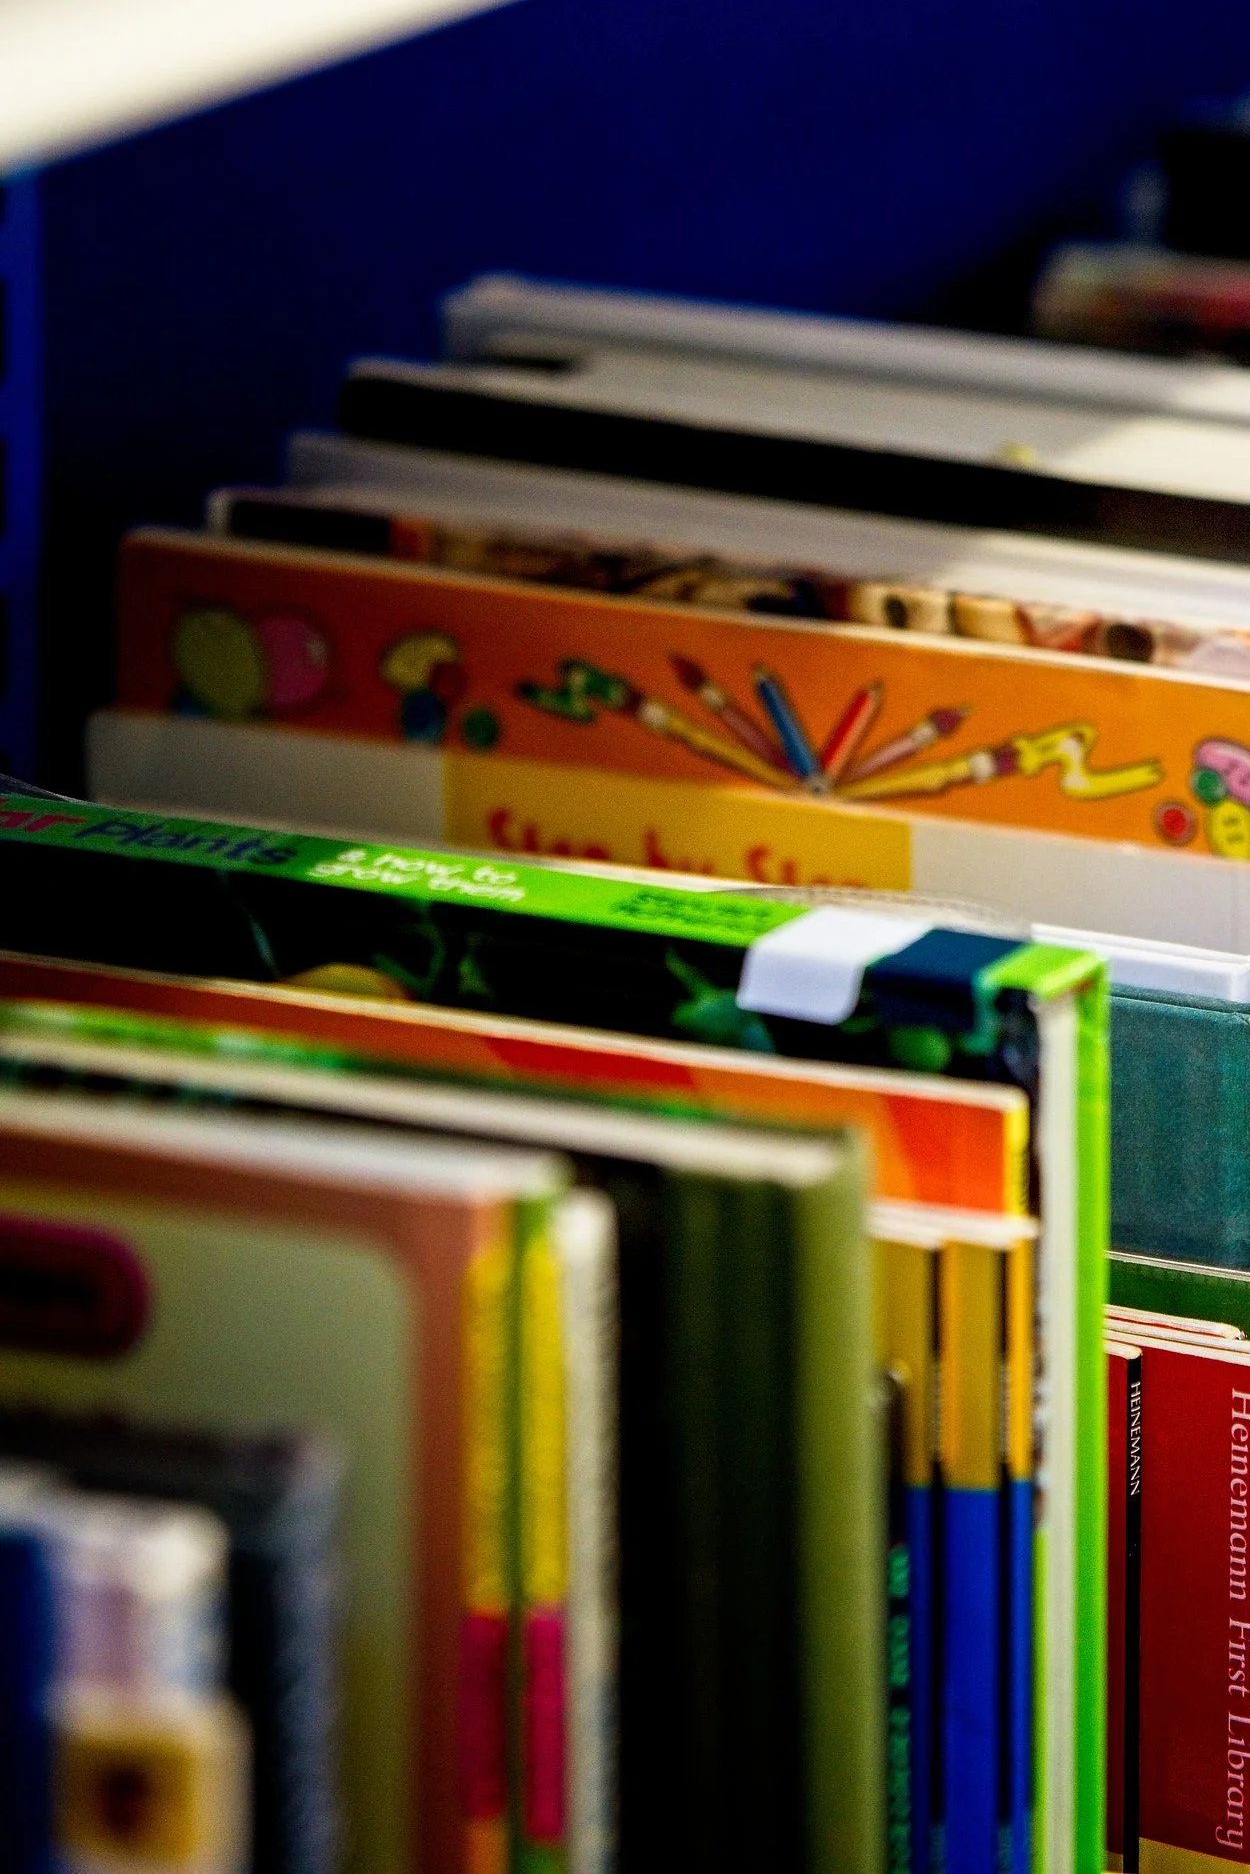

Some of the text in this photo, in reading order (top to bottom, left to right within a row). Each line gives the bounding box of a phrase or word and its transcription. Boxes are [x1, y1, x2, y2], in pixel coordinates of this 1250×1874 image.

[72, 818, 298, 866] Plants
[308, 862, 526, 902] grow them
[373, 853, 466, 877] how
[473, 866, 518, 886] to
[1130, 1382, 1141, 1496] HEINEMANN
